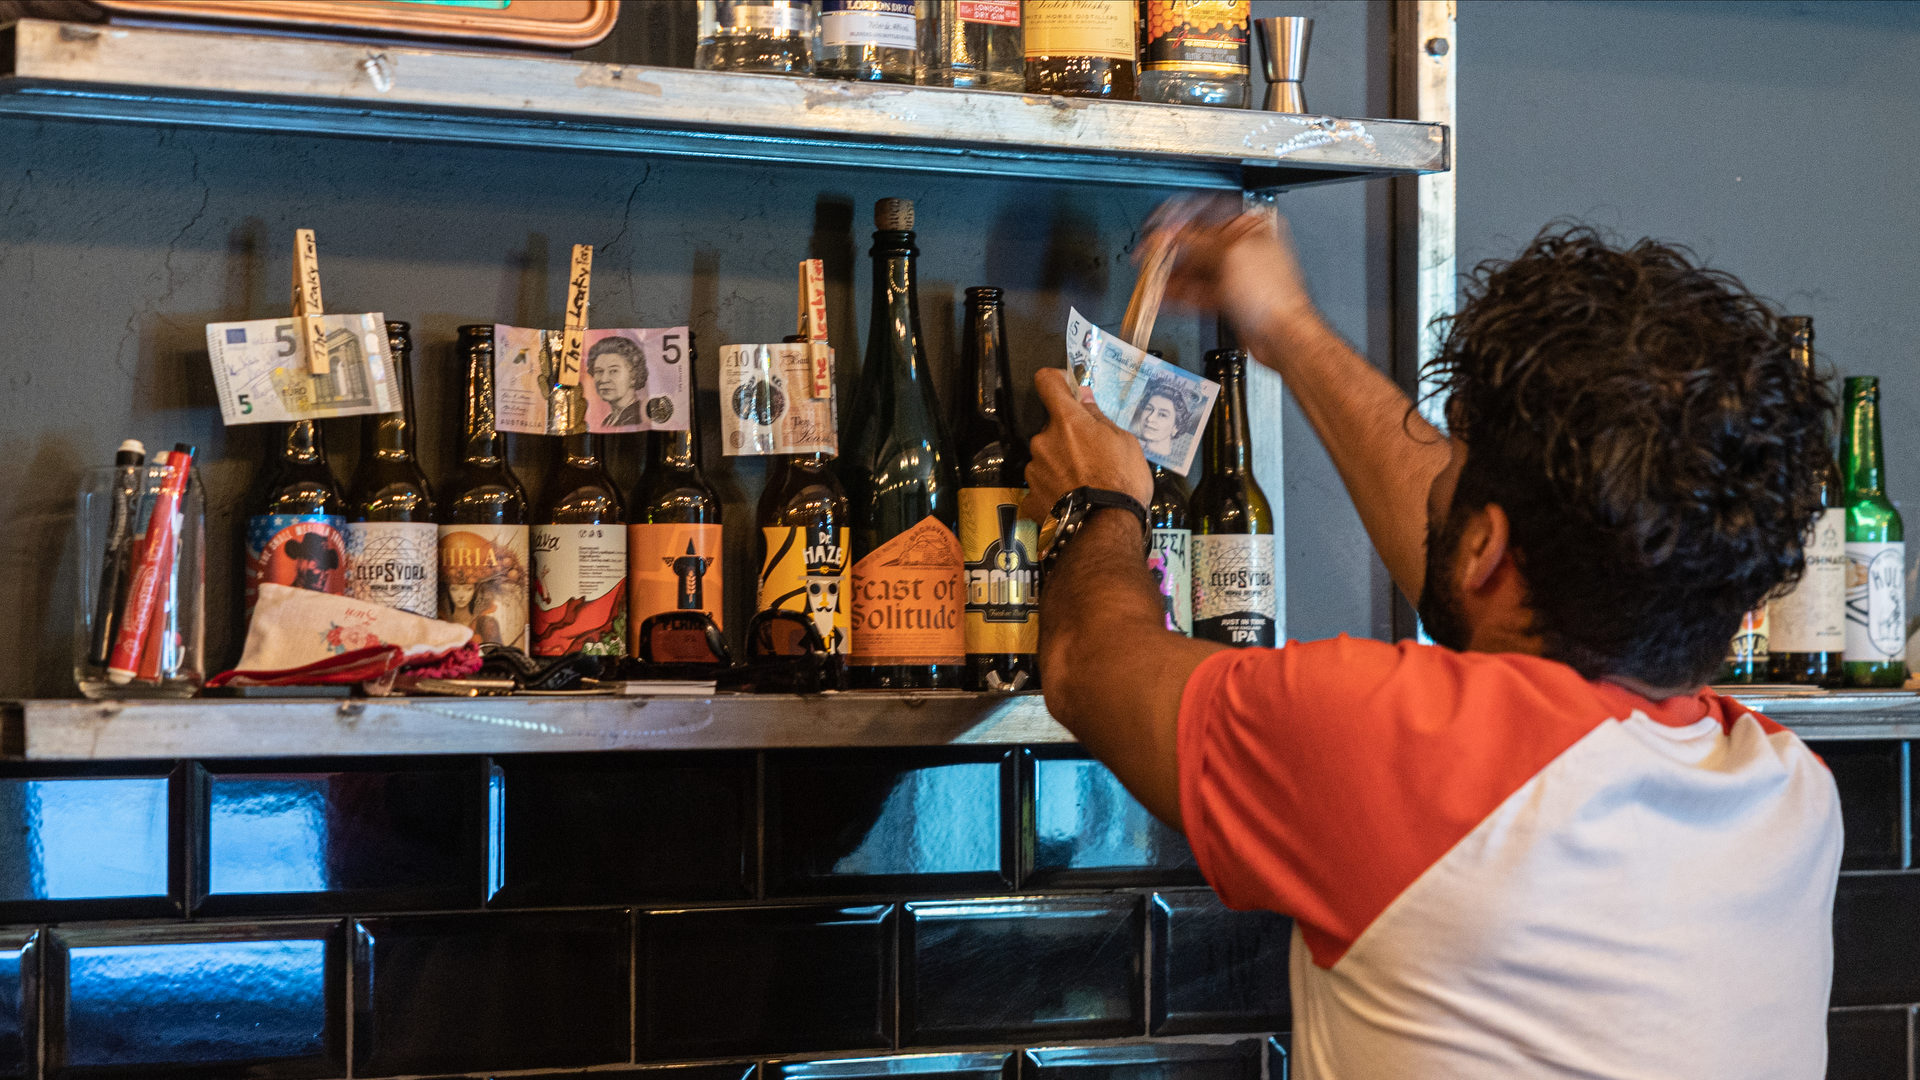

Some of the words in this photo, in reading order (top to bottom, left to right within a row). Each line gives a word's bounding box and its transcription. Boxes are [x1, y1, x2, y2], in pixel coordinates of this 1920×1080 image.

[974, 4, 1005, 13] LONDON
[304, 233, 317, 262] Tap
[306, 267, 321, 312] Leaky
[274, 324, 297, 358] 5
[314, 324, 328, 361] The
[662, 334, 682, 365] 5
[563, 337, 582, 374] The
[727, 349, 750, 368] £10
[237, 394, 254, 415] 5
[499, 417, 543, 428] AUSTRALIA
[818, 530, 832, 545] DE
[802, 545, 844, 565] HAZE
[356, 562, 428, 583] CLEPSYDRA
[851, 574, 925, 601] Feast
[933, 574, 958, 601] of
[851, 602, 957, 631] Solitude
[1231, 630, 1258, 643] IPA
